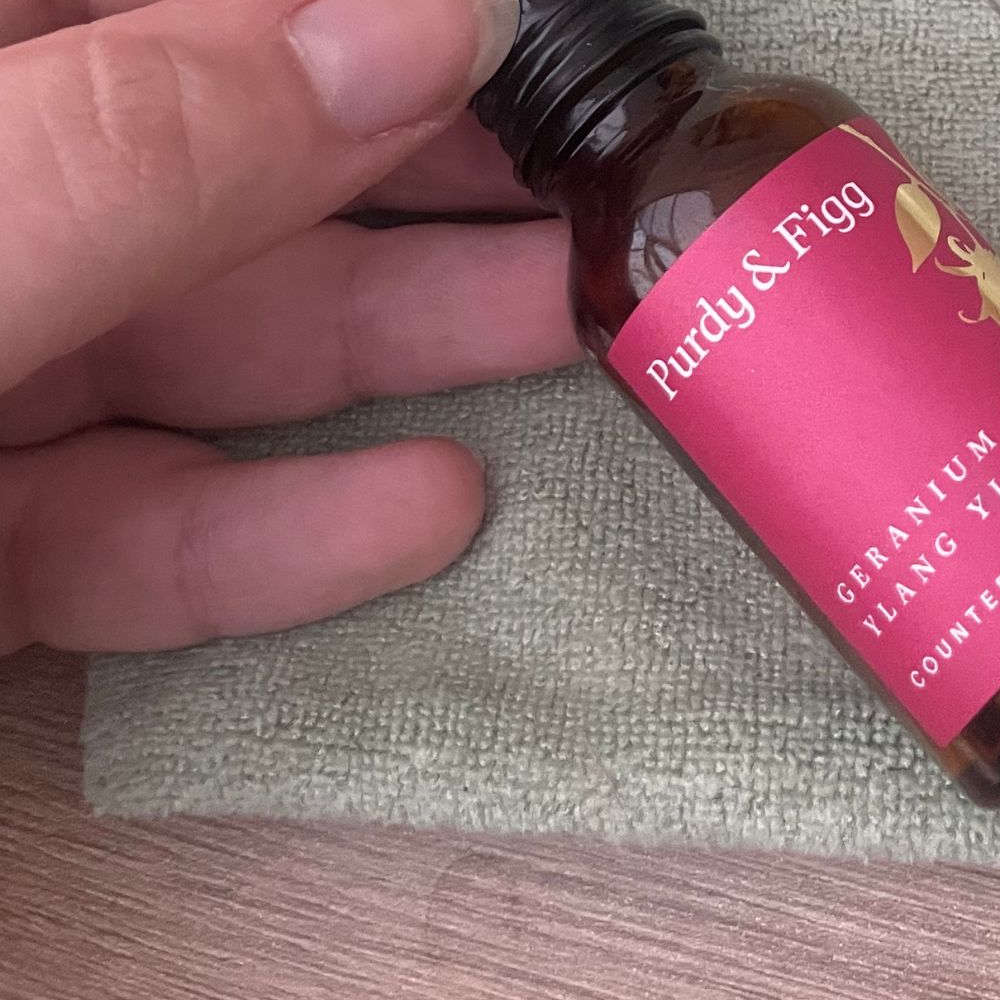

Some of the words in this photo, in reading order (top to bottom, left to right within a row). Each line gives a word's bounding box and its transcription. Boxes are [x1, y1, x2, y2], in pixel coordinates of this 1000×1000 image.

[645, 284, 756, 401] Purdy
[742, 248, 791, 292] &
[772, 181, 876, 261] Figg
[836, 429, 997, 605] GERANIUM
[862, 531, 957, 638] YLANG
